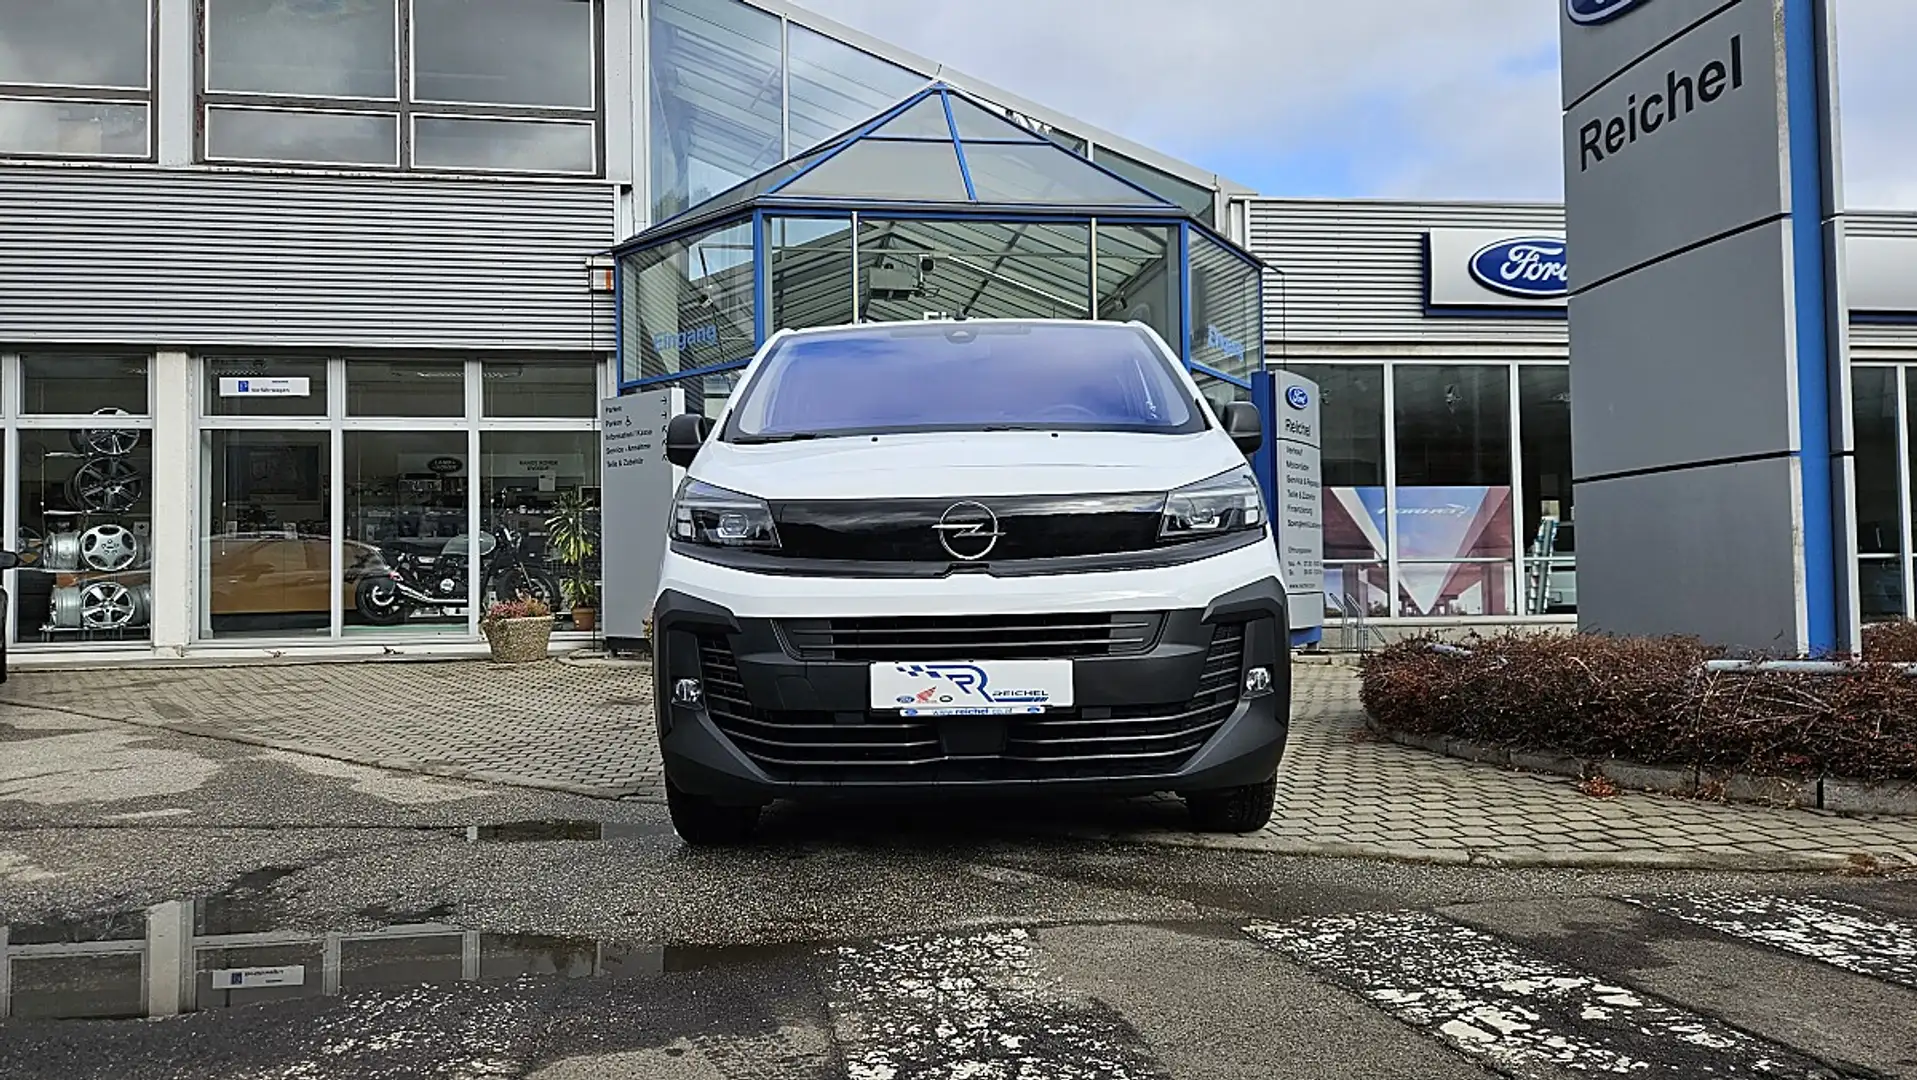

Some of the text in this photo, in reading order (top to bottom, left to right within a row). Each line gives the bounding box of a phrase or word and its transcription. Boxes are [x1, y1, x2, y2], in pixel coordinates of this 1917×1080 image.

[1580, 34, 1742, 172] Reichel
[653, 324, 717, 352] Eingang
[1285, 418, 1311, 437] Reichel
[606, 446, 624, 454] Service
